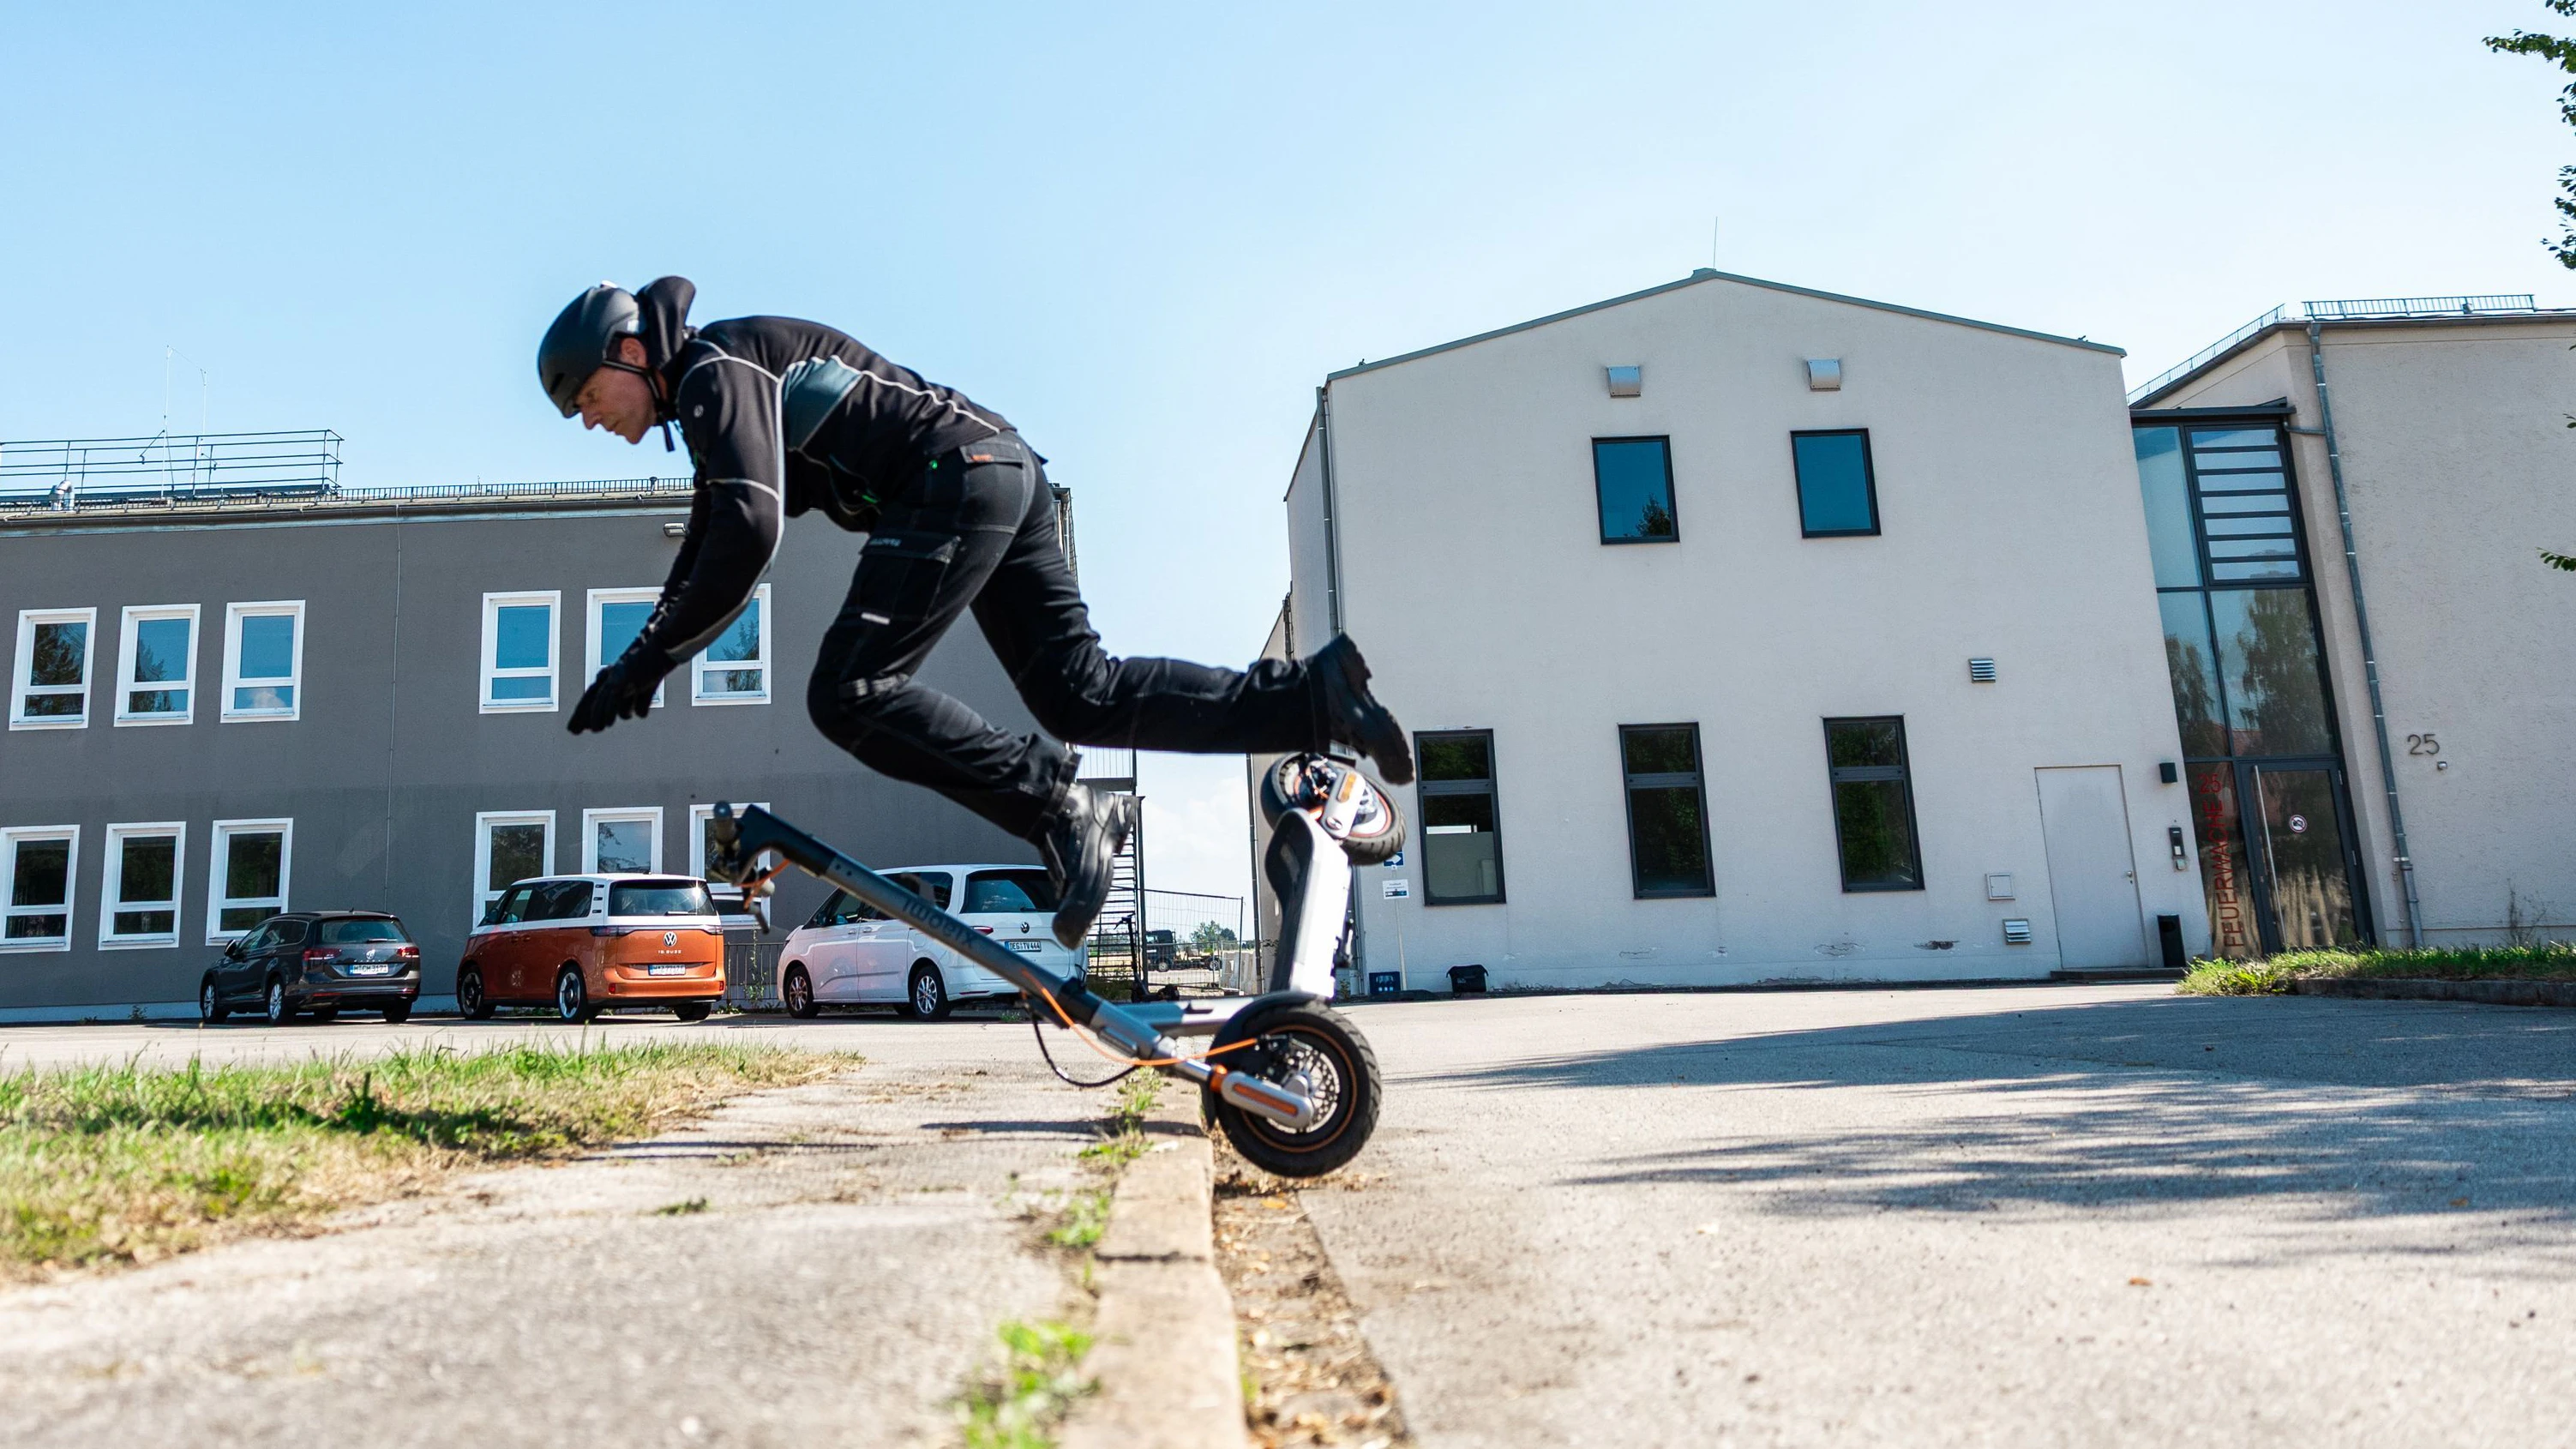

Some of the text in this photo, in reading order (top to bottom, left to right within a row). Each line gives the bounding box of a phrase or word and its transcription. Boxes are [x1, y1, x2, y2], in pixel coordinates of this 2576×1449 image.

[2407, 733, 2441, 755] 25
[2198, 773, 2244, 947] FEUERWACHE 25
